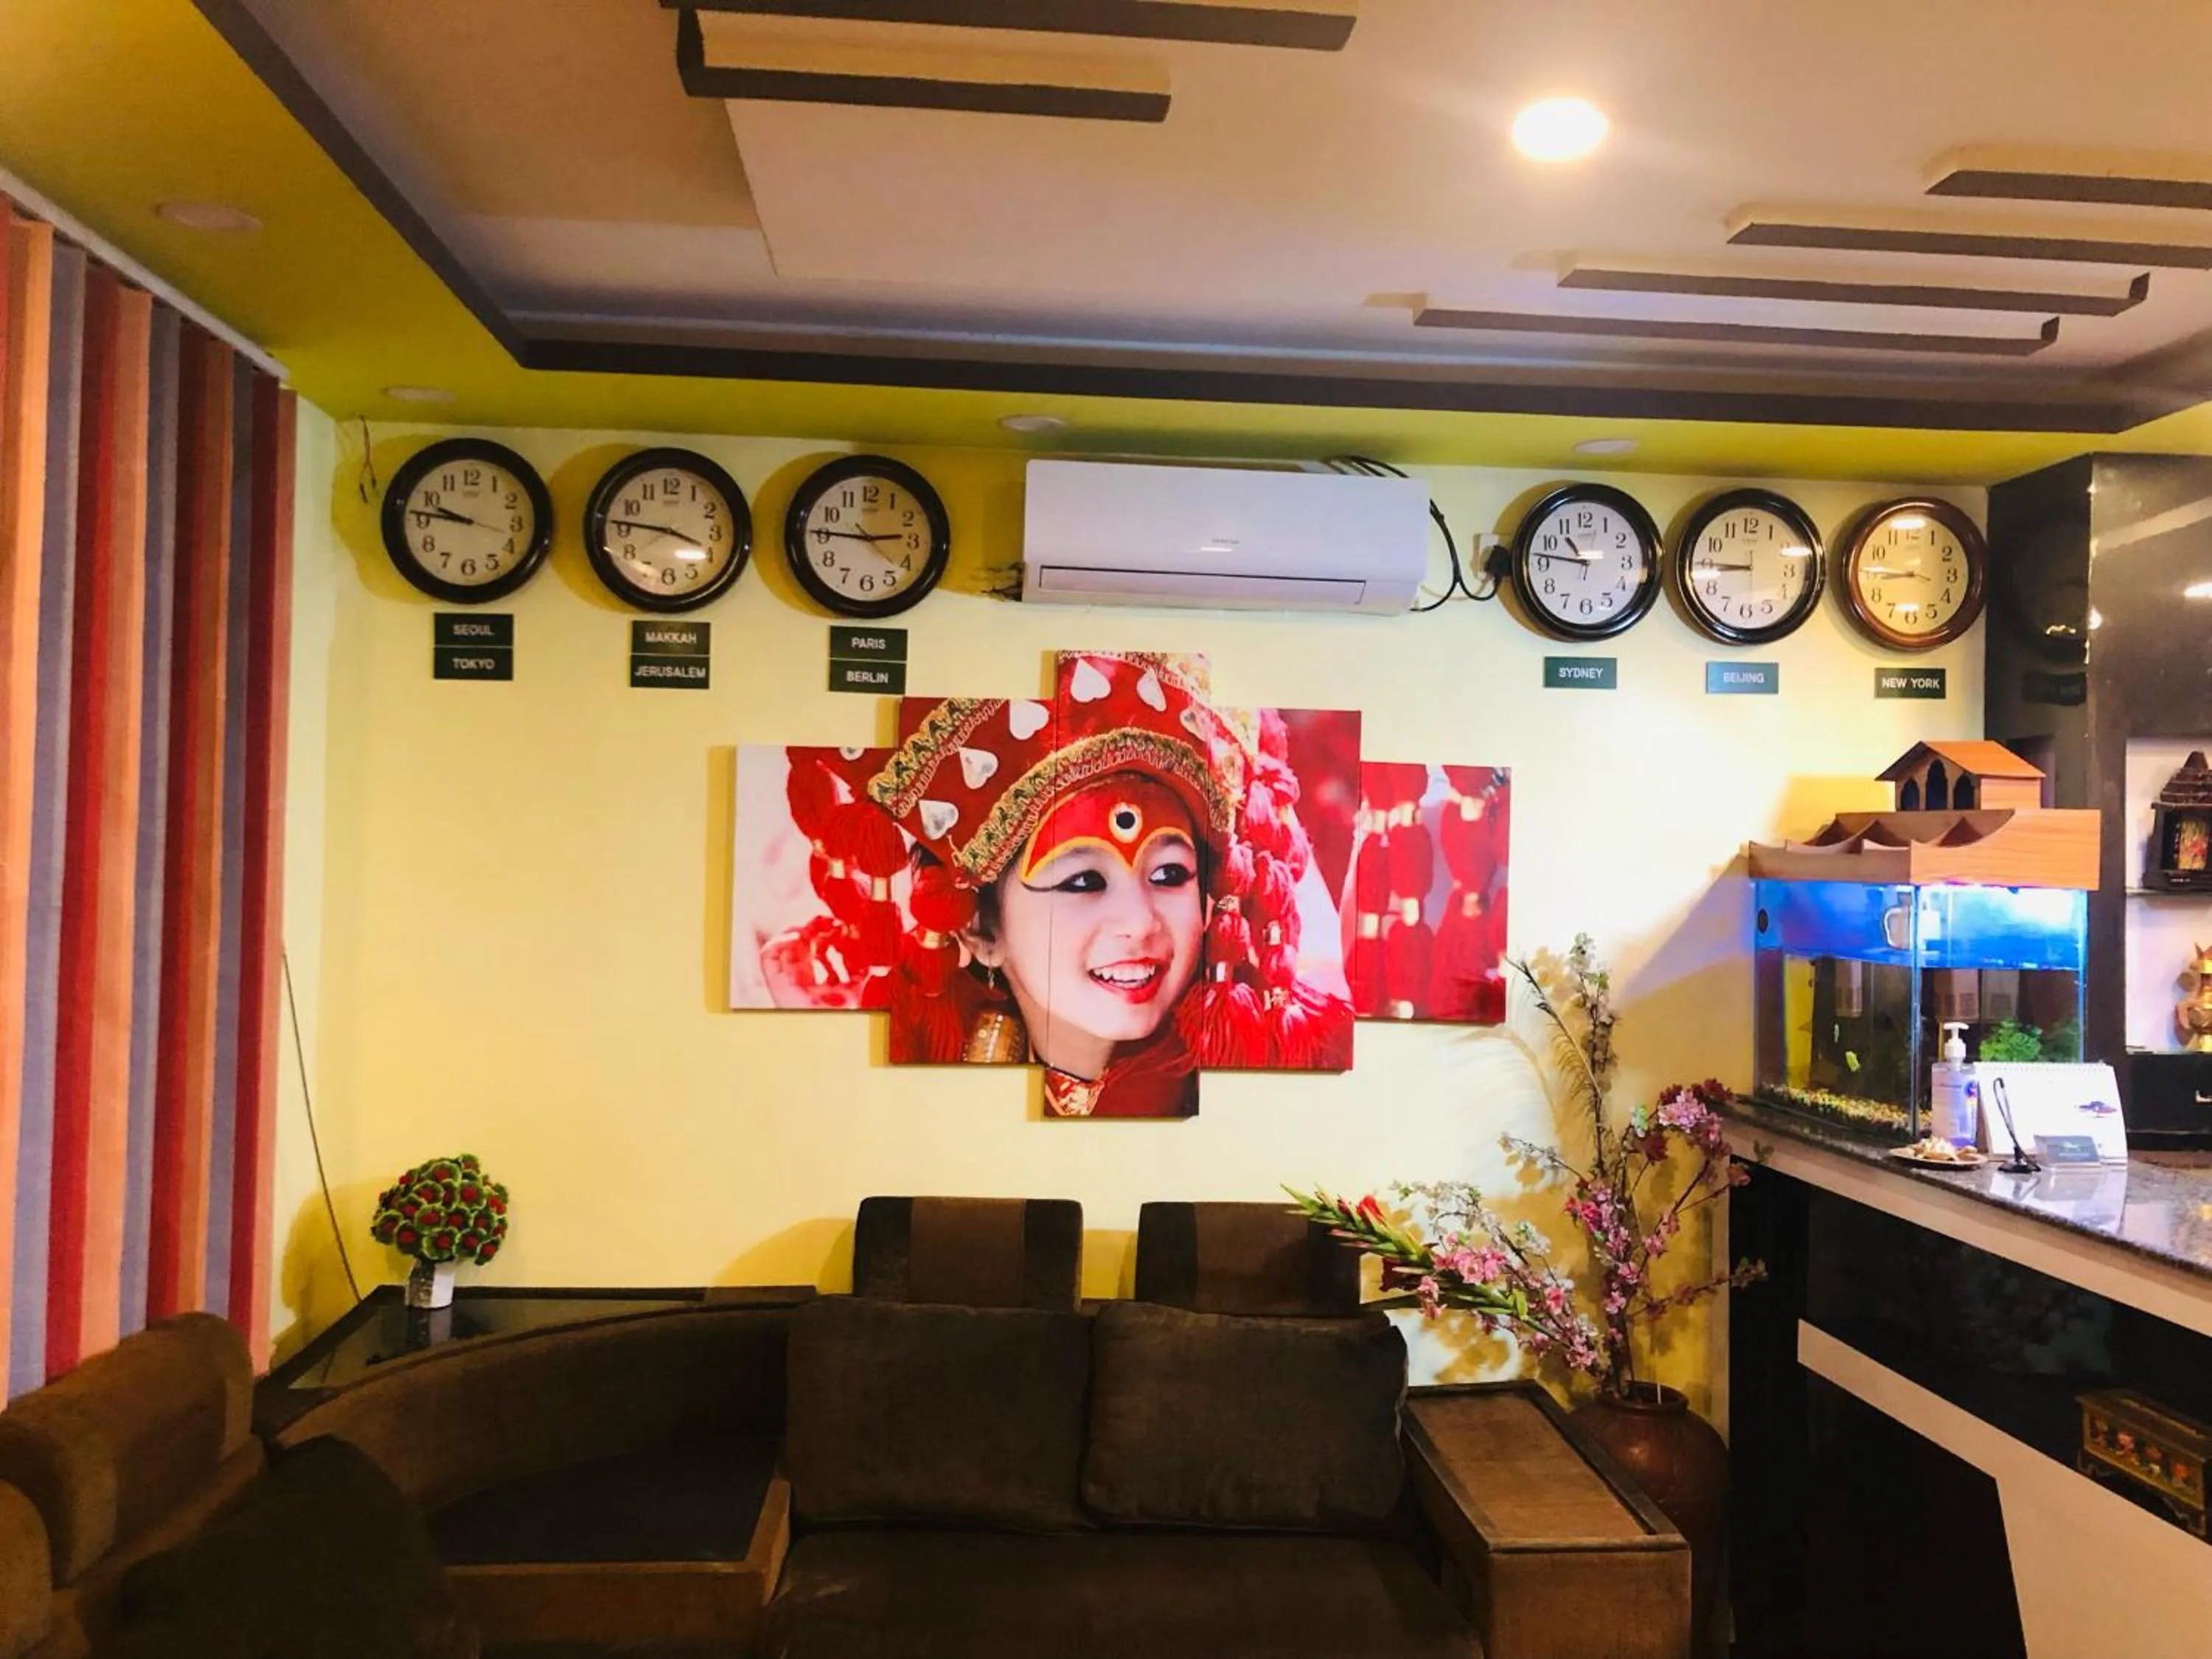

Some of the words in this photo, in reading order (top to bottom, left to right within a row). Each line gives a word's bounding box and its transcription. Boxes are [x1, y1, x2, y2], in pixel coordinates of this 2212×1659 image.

[442, 475, 455, 491] 11
[463, 469, 480, 486] 12
[492, 476, 498, 493] 1
[642, 484, 655, 500] 11
[664, 478, 681, 495] 12
[690, 485, 697, 501] 1
[424, 491, 440, 507] 10
[505, 493, 517, 509] 2
[842, 491, 855, 507] 11
[863, 486, 880, 503] 12
[889, 493, 896, 509] 1
[625, 500, 641, 516] 10
[703, 502, 717, 518] 2
[824, 507, 840, 523] 10
[416, 513, 431, 529] 9
[509, 517, 523, 532] 3
[902, 511, 914, 526] 2
[1578, 512, 1593, 528] 12
[1603, 518, 1608, 532] 1
[1743, 518, 1759, 534] 12
[616, 522, 631, 538] 9
[709, 526, 722, 542] 3
[1559, 519, 1570, 534] 11
[1725, 523, 1736, 538] 11
[1769, 525, 1773, 540] 1
[422, 536, 435, 552] 8
[503, 538, 515, 554] 4
[907, 532, 919, 549] 3
[1543, 535, 1557, 549] 10
[1615, 533, 1627, 549] 2
[1708, 537, 1722, 552] 10
[1888, 531, 1898, 546] 11
[1930, 531, 1935, 546] 1
[624, 545, 636, 560] 8
[823, 552, 835, 567] 8
[1872, 546, 1885, 560] 10
[1942, 547, 1952, 562] 2
[439, 552, 451, 569] 7
[462, 559, 476, 575] 6
[485, 554, 499, 571] 5
[900, 555, 911, 571] 4
[1537, 557, 1550, 572] 9
[1622, 556, 1632, 569] 3
[661, 568, 676, 585] 6
[685, 564, 698, 580] 5
[840, 568, 849, 584] 7
[883, 571, 896, 586] 5
[1784, 565, 1795, 578] 3
[1947, 568, 1958, 582] 3
[860, 575, 874, 591] 6
[1544, 578, 1555, 594] 8
[1705, 581, 1717, 596] 8
[1560, 594, 1571, 609] 7
[1601, 593, 1613, 608] 5
[1871, 588, 1882, 603] 8
[1941, 588, 1951, 603] 4
[1580, 599, 1593, 615] 6
[1722, 597, 1731, 612] 7
[1761, 599, 1773, 613] 5
[1888, 603, 1896, 619] 7
[1926, 605, 1938, 619] 5
[453, 625, 493, 635] SEOUL
[646, 632, 697, 644] MAKKAH
[852, 638, 886, 650] PARIS
[453, 658, 495, 669] TOKYO
[635, 667, 706, 678] JERUSALEM
[846, 671, 888, 683] BERLIN
[1559, 668, 1604, 678] SYDNEY
[1723, 672, 1764, 683] BEIJING
[1882, 678, 1907, 688] NEW
[1911, 678, 1940, 689] YORK
